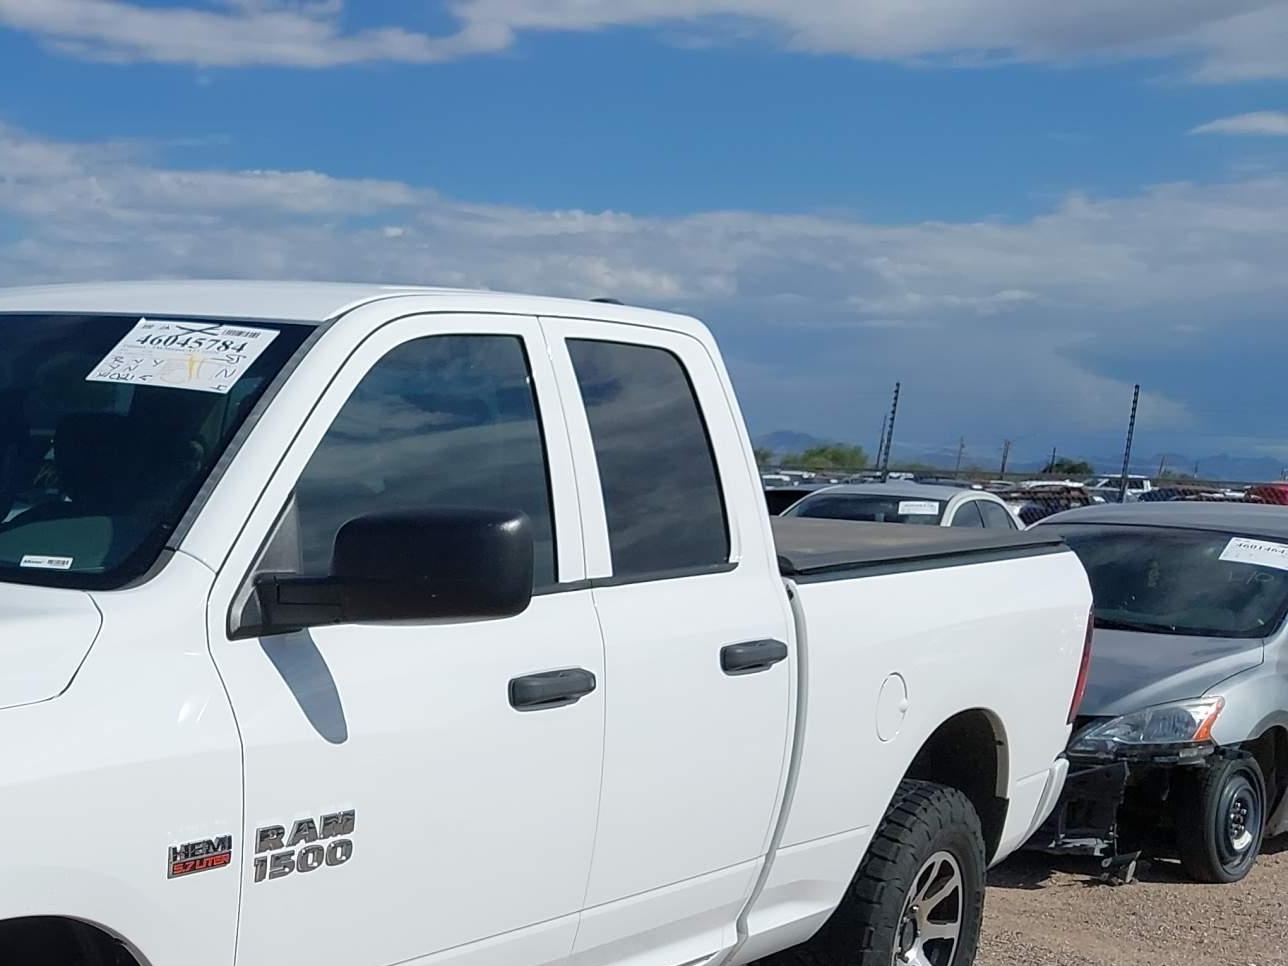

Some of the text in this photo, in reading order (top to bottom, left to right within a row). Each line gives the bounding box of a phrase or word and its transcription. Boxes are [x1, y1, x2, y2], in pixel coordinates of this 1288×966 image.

[136, 333, 248, 353] 46045784
[255, 809, 355, 854] RAM
[170, 835, 233, 862] HEMI
[253, 838, 354, 884] 1500
[172, 853, 231, 875] 5.7 LITER
